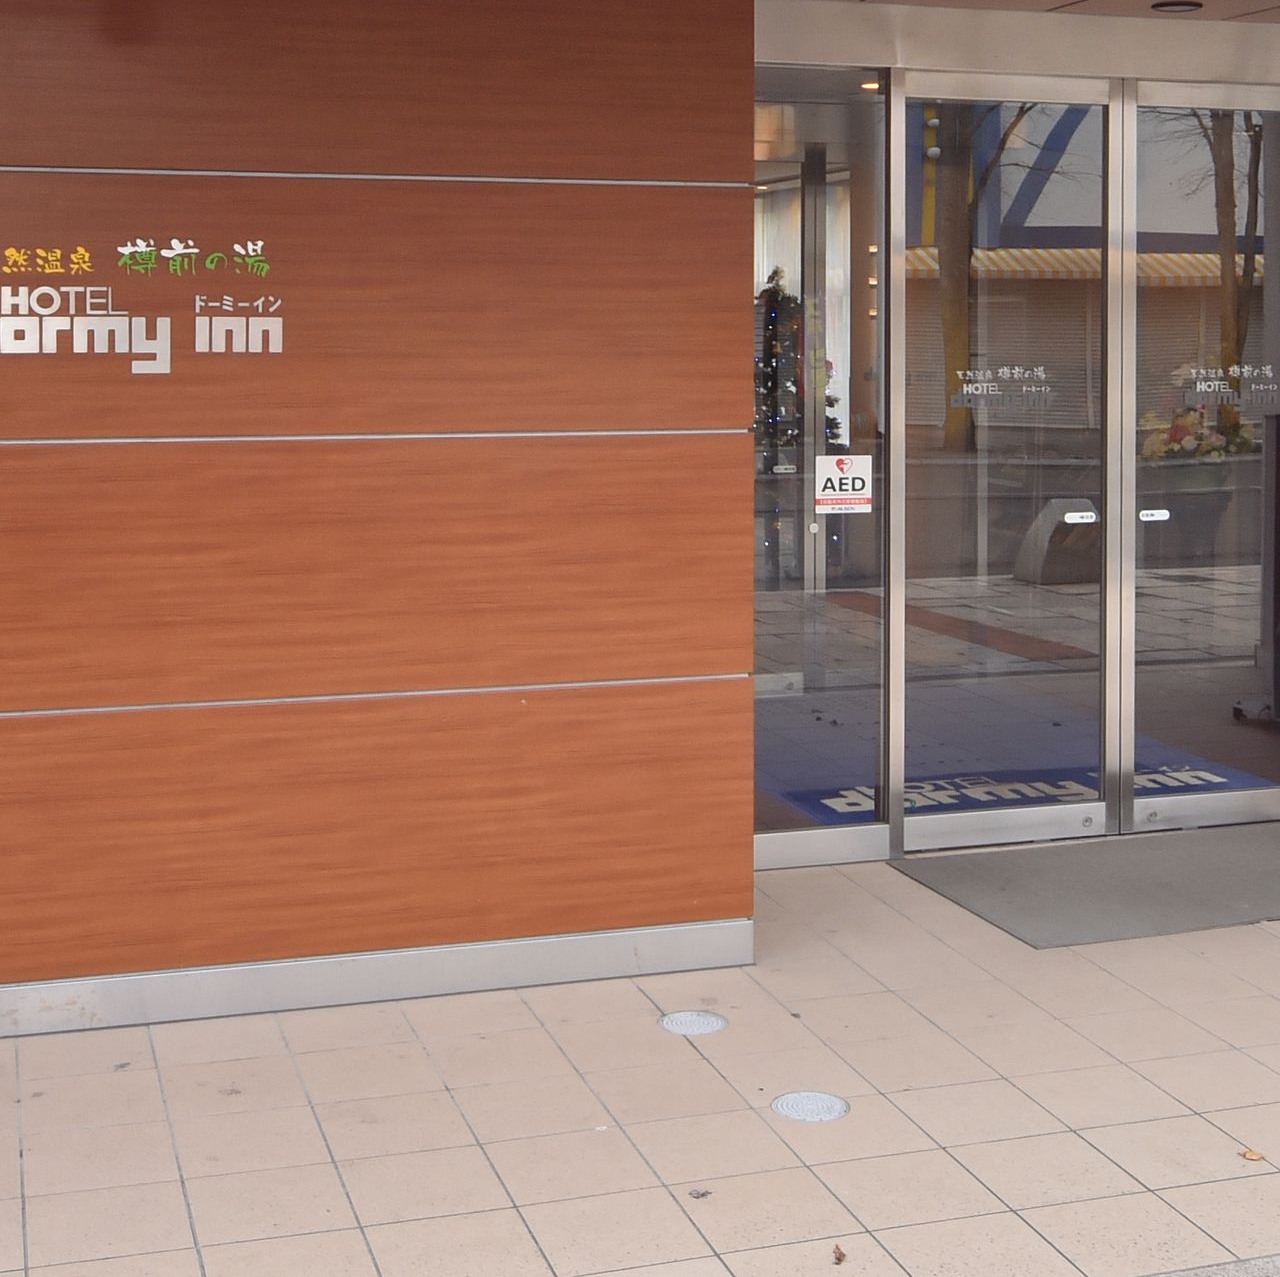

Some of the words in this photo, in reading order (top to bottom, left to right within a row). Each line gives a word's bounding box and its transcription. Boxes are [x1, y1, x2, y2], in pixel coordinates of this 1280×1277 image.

[116, 237, 271, 279] 樽前の湯
[0, 286, 129, 316] HOTEL
[194, 294, 283, 314] ドーミーイン
[194, 316, 284, 354] inn
[962, 382, 1003, 395] HOTEL
[1196, 381, 1233, 392] HOTEL
[821, 476, 866, 493] AED
